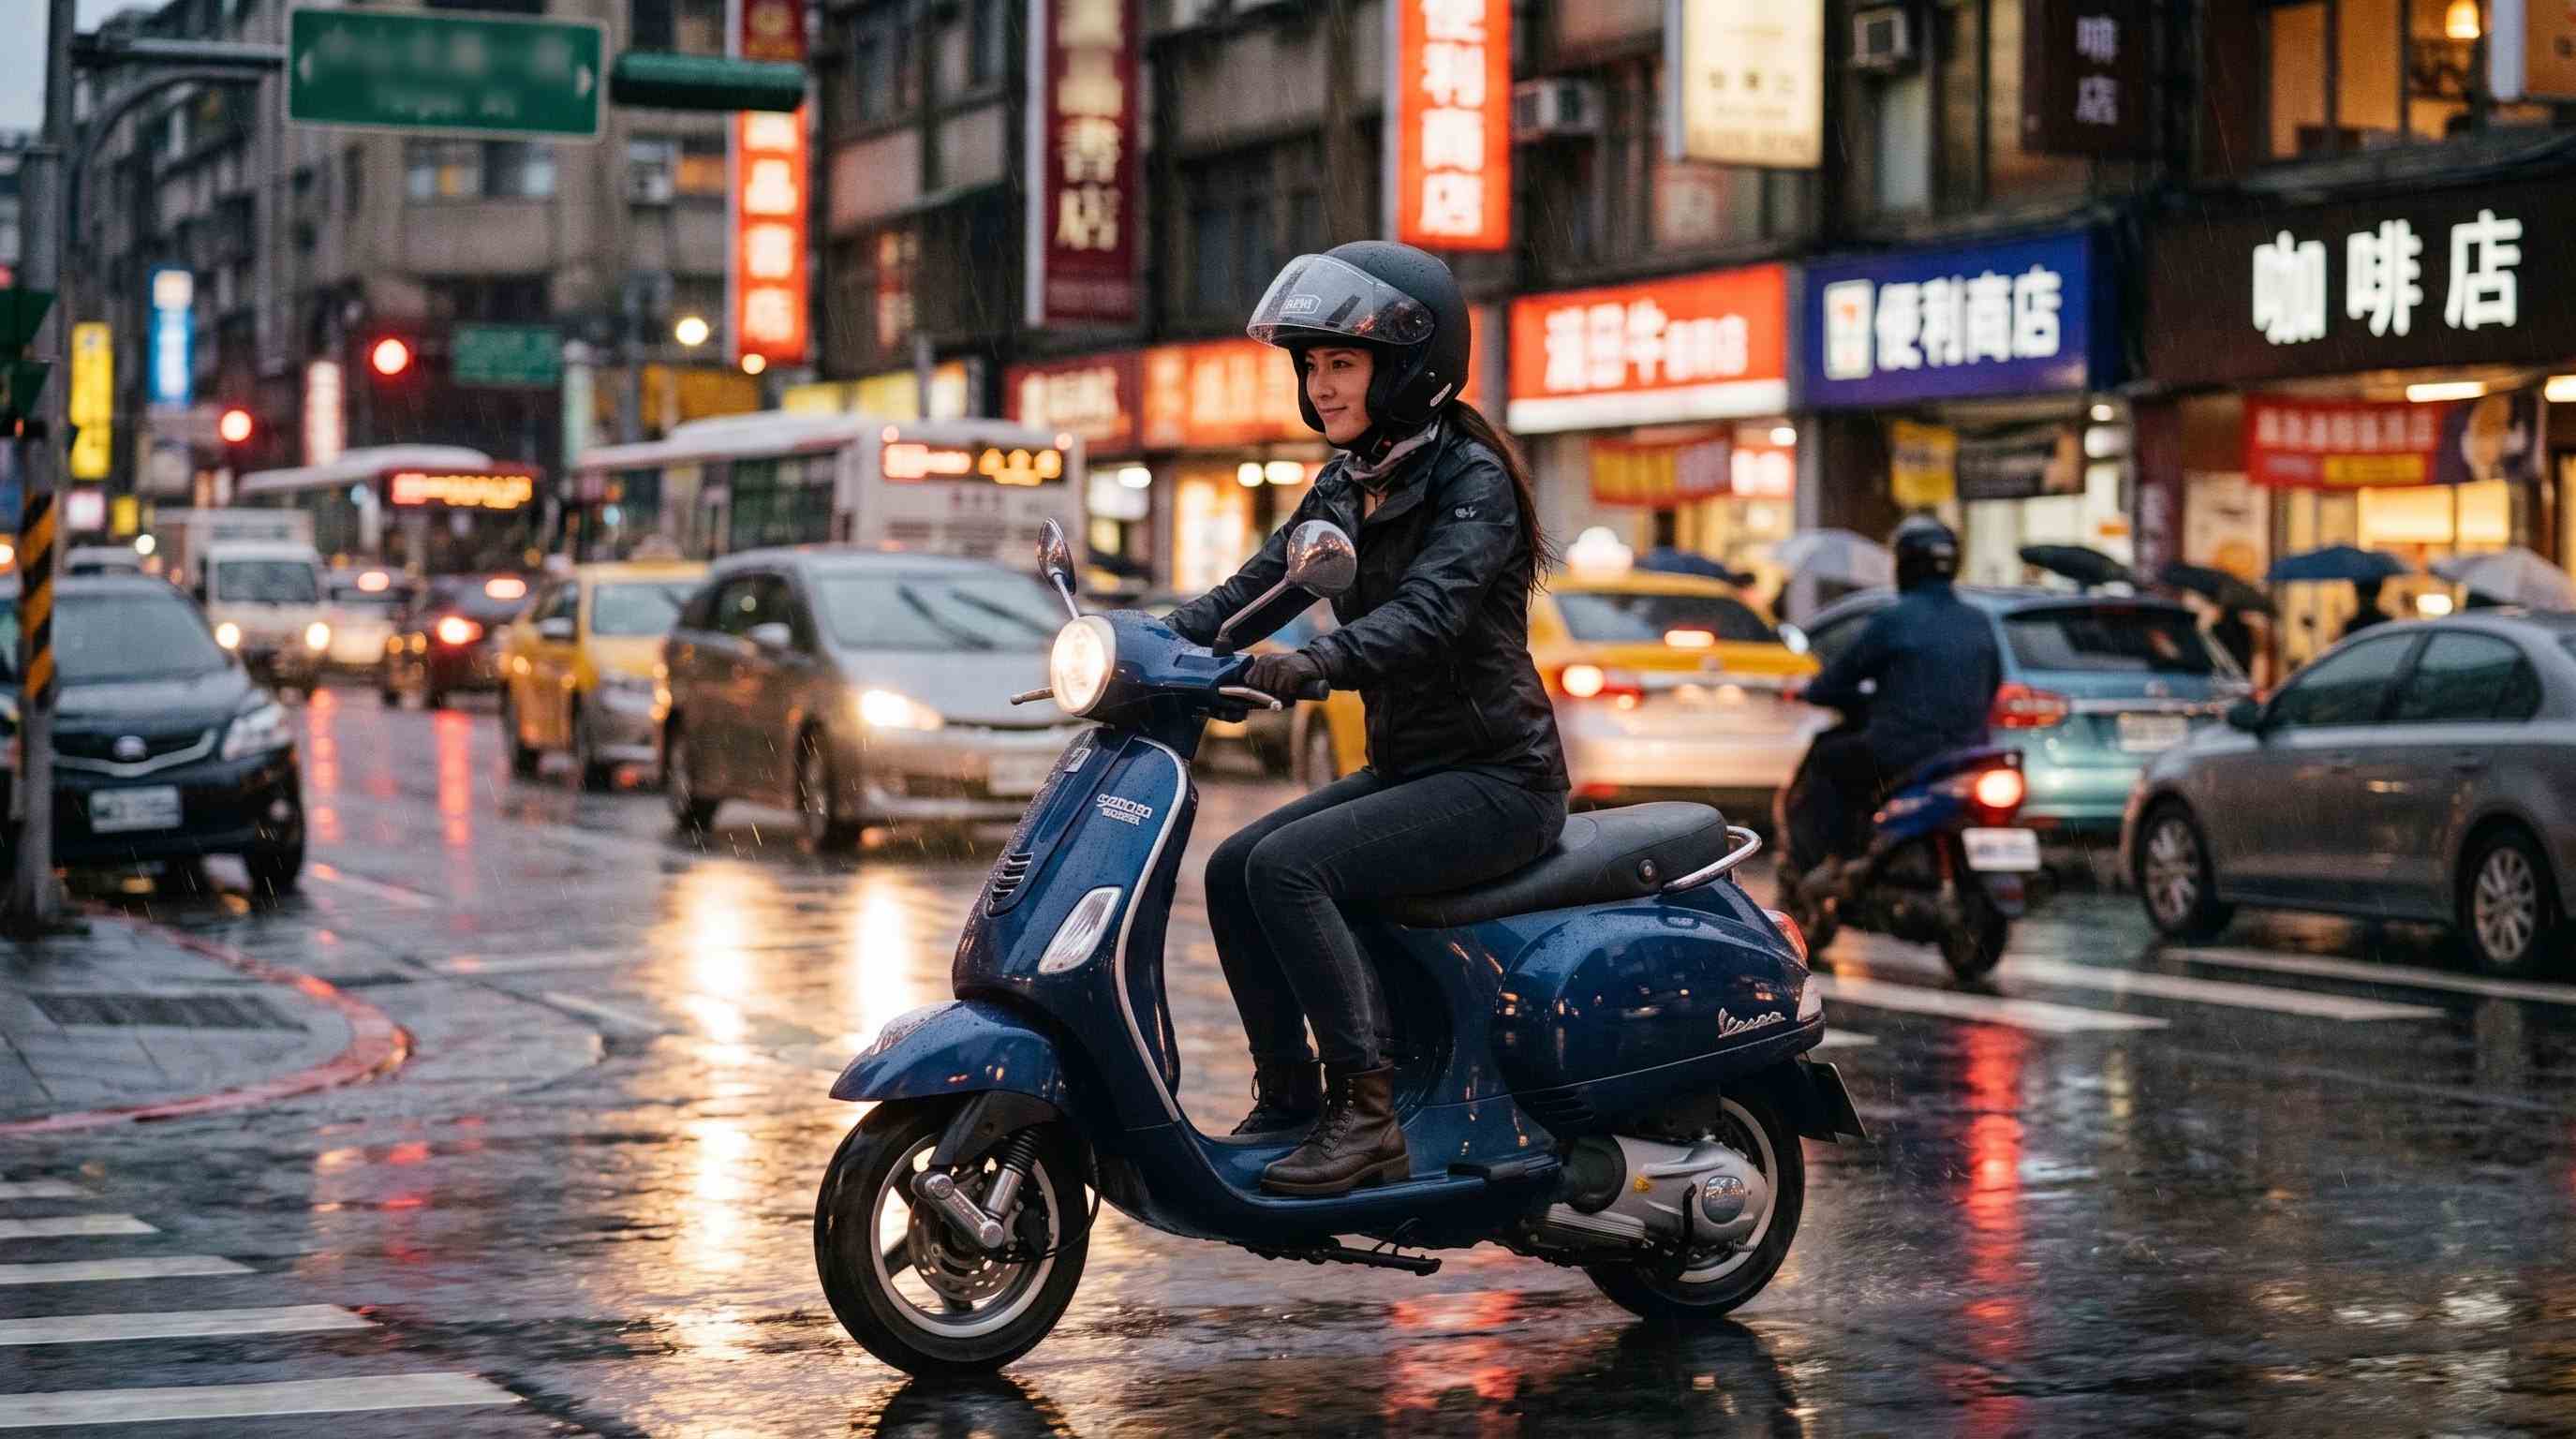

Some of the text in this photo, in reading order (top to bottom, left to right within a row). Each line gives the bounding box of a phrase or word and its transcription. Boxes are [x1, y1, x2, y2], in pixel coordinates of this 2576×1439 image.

[1875, 263, 2062, 371] 便利商店
[2253, 208, 2523, 345] 咖啡店
